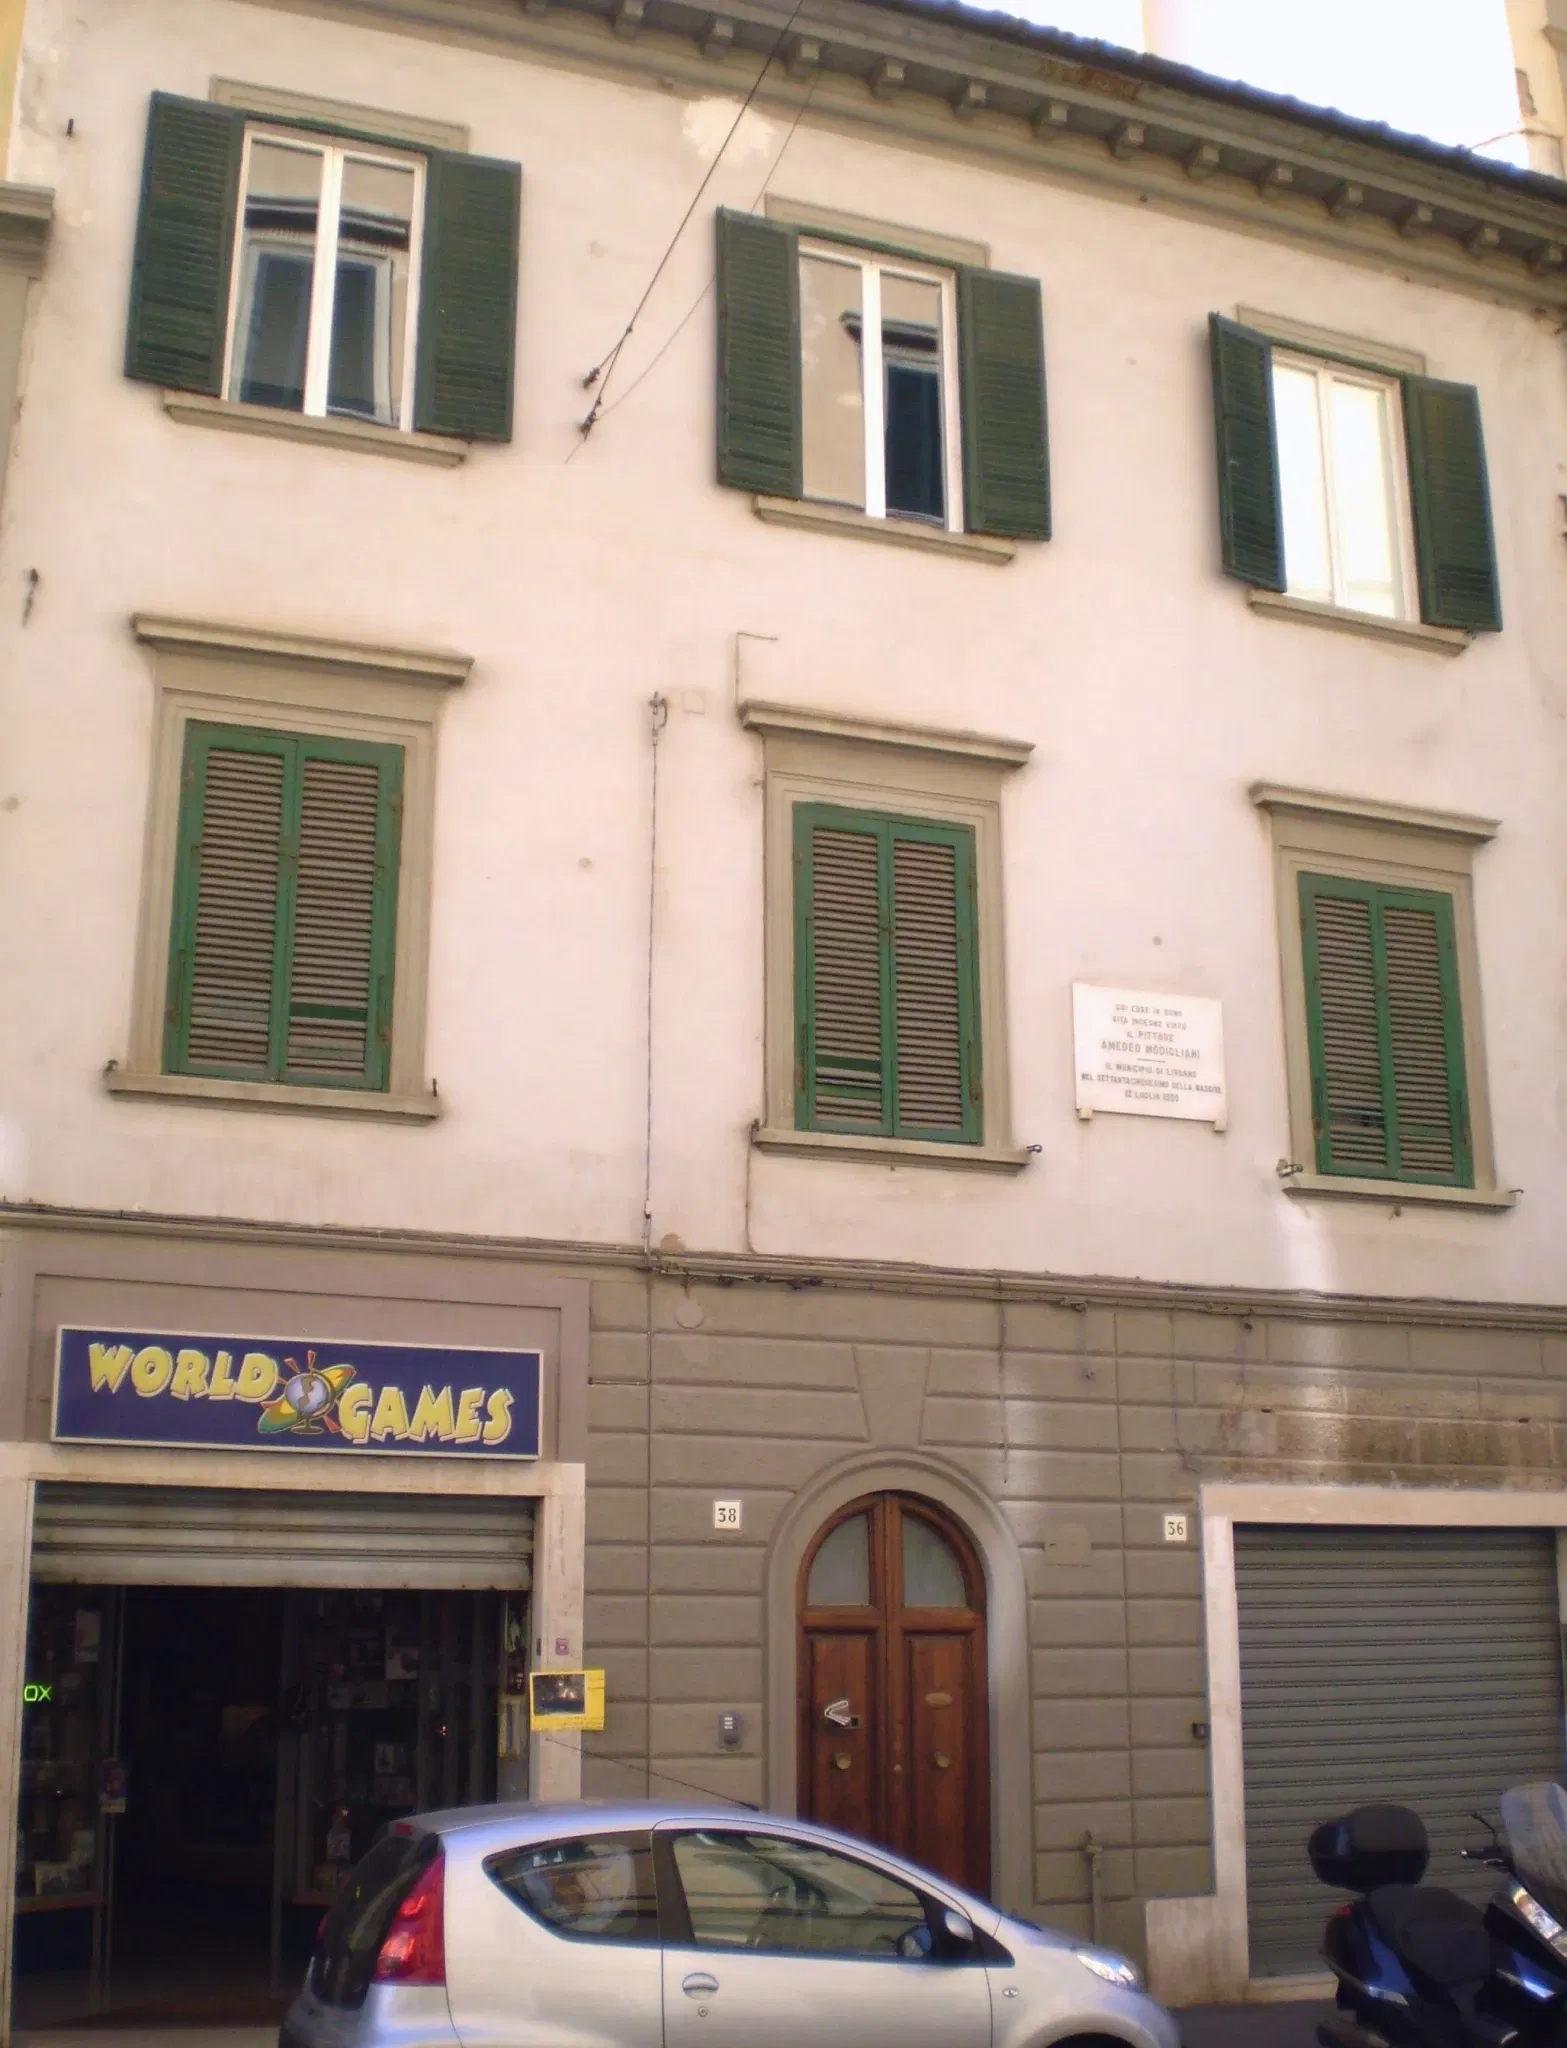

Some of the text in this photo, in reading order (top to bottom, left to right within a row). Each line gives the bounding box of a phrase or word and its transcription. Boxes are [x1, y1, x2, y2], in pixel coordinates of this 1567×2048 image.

[1138, 1031, 1174, 1042] PITTORE
[1101, 1040, 1200, 1058] AMEDEO MODIGLIANI
[1116, 1064, 1152, 1073] MUNICIPIO
[88, 1342, 514, 1445] WORLD GAMES
[718, 1508, 736, 1523] 38
[1167, 1521, 1184, 1536] 36
